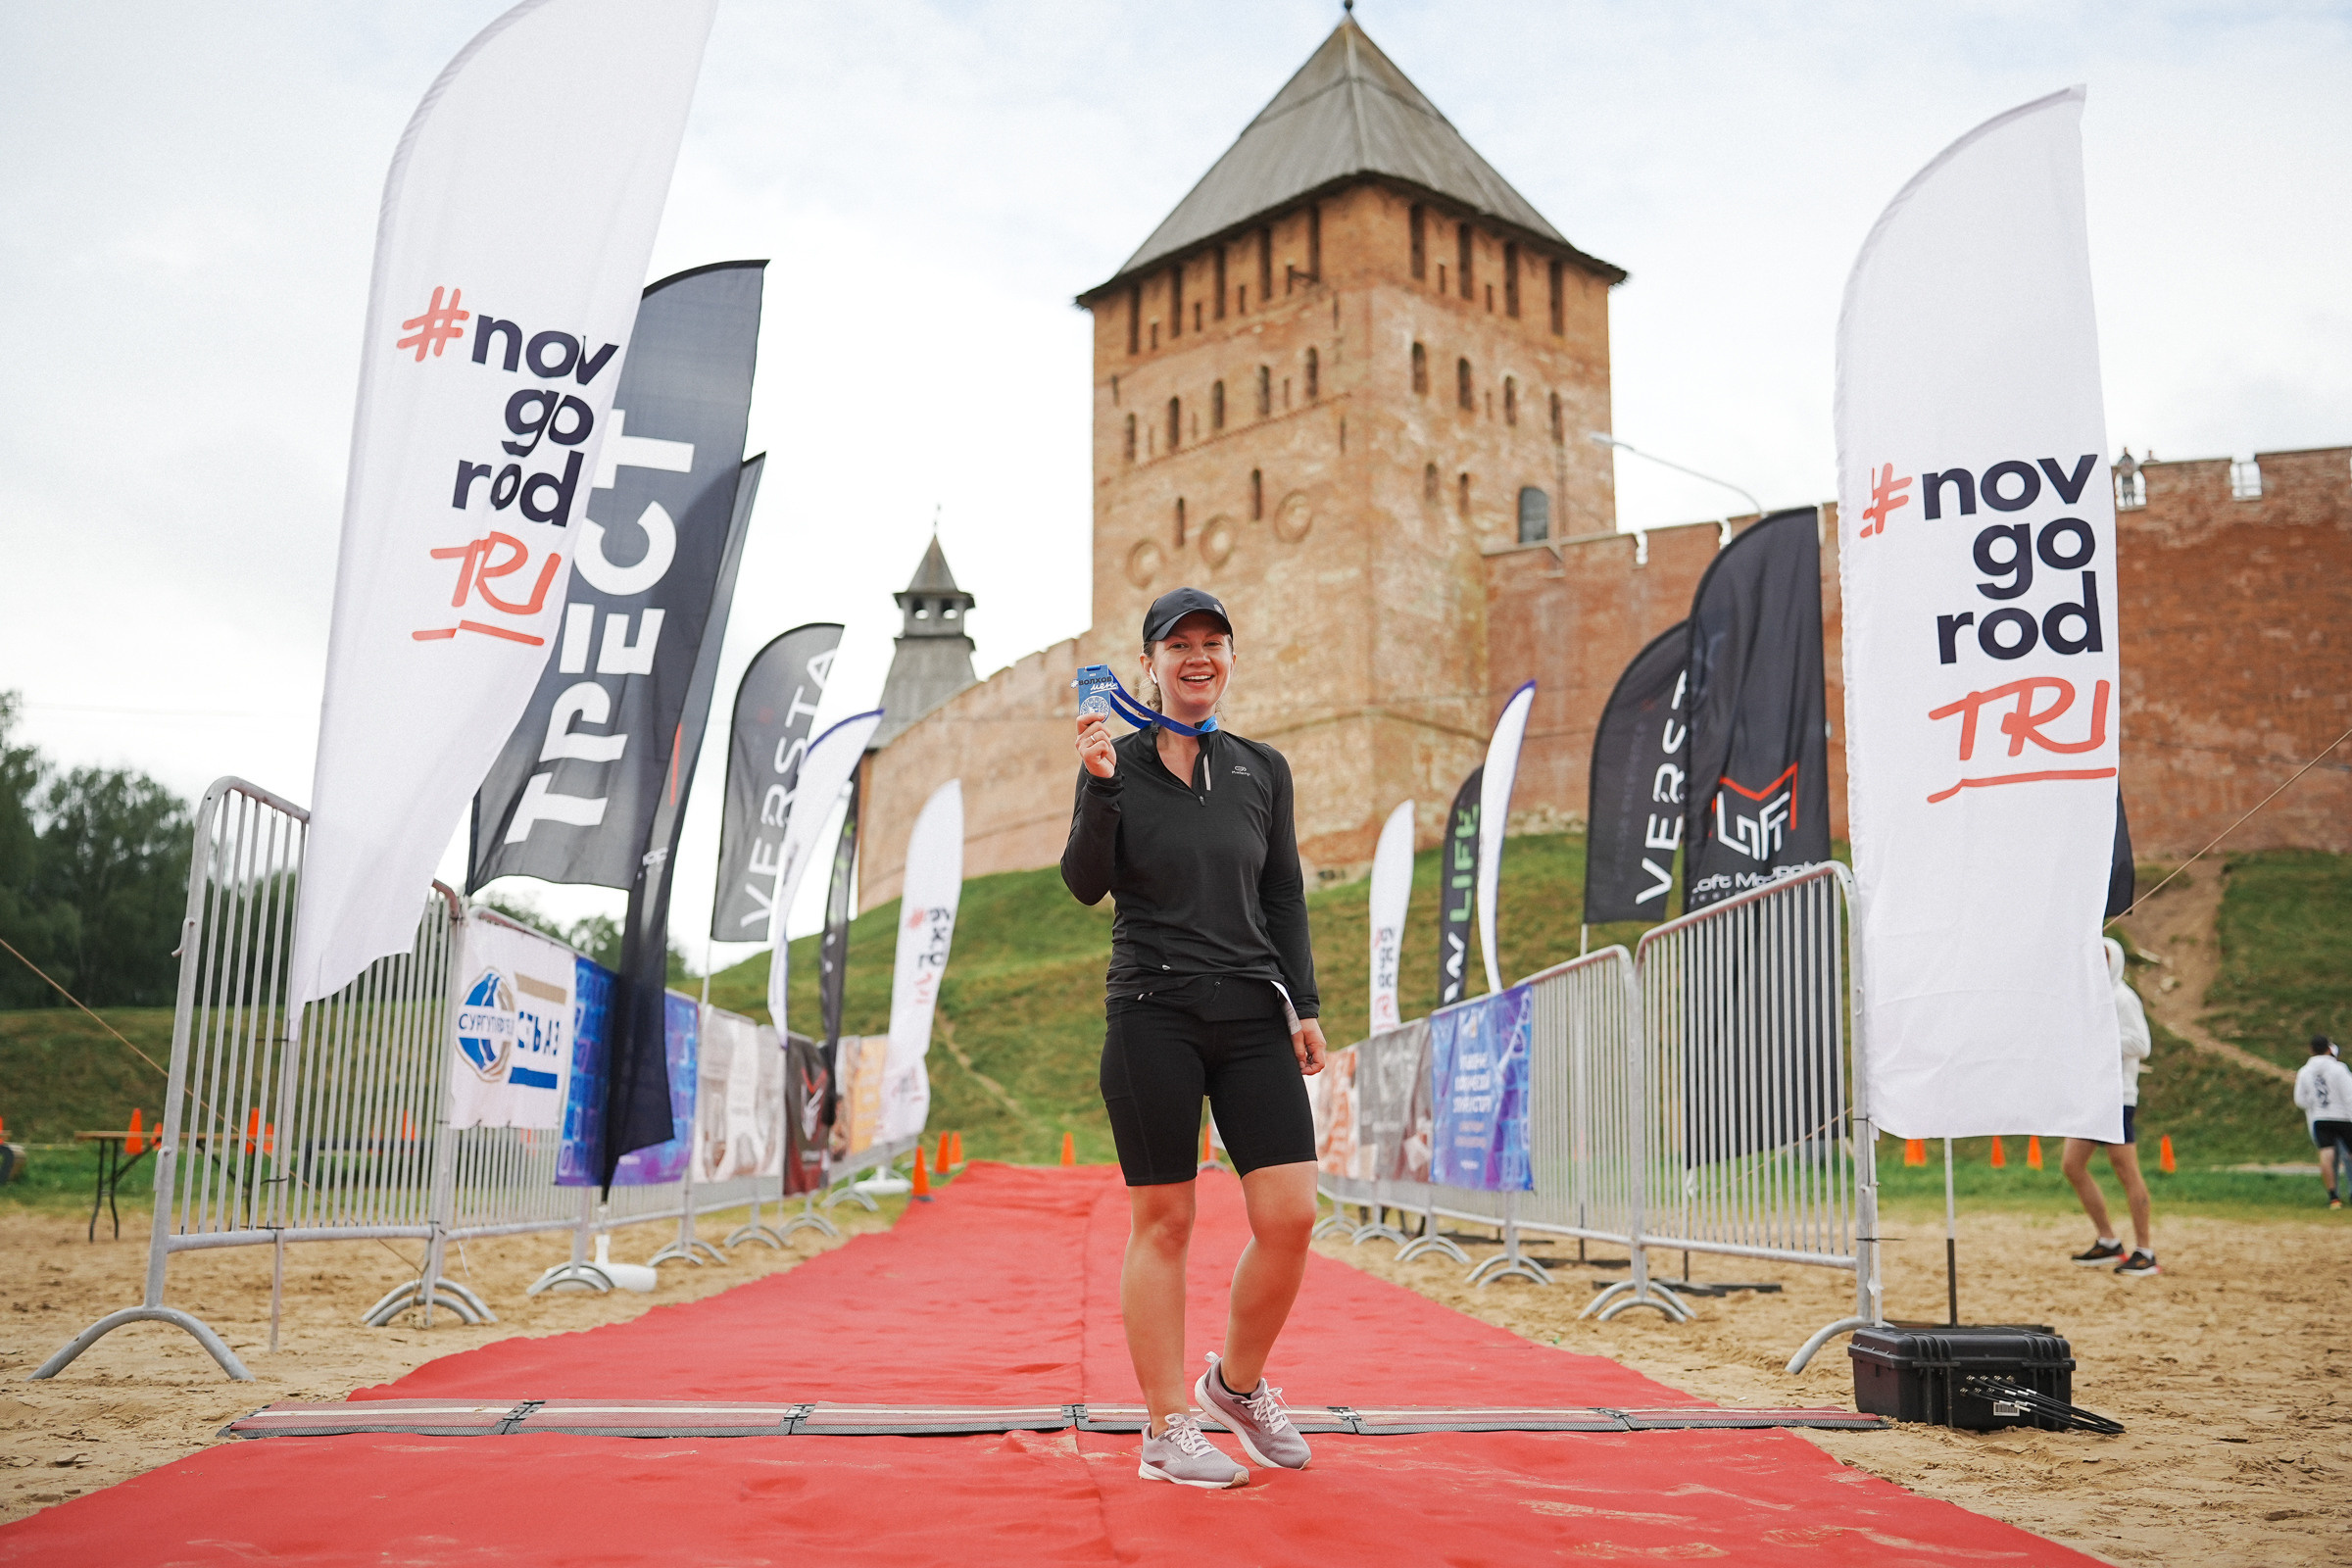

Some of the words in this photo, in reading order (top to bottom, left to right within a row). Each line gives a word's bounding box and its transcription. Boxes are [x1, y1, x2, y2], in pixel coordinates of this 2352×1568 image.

[501, 388, 594, 458] go
[452, 450, 585, 527] rod
[429, 530, 562, 615] TRI
[1972, 516, 2096, 601] go
[504, 408, 695, 845] ТРЕСТ
[1936, 569, 2104, 665] rod
[1928, 676, 2111, 761] TRI
